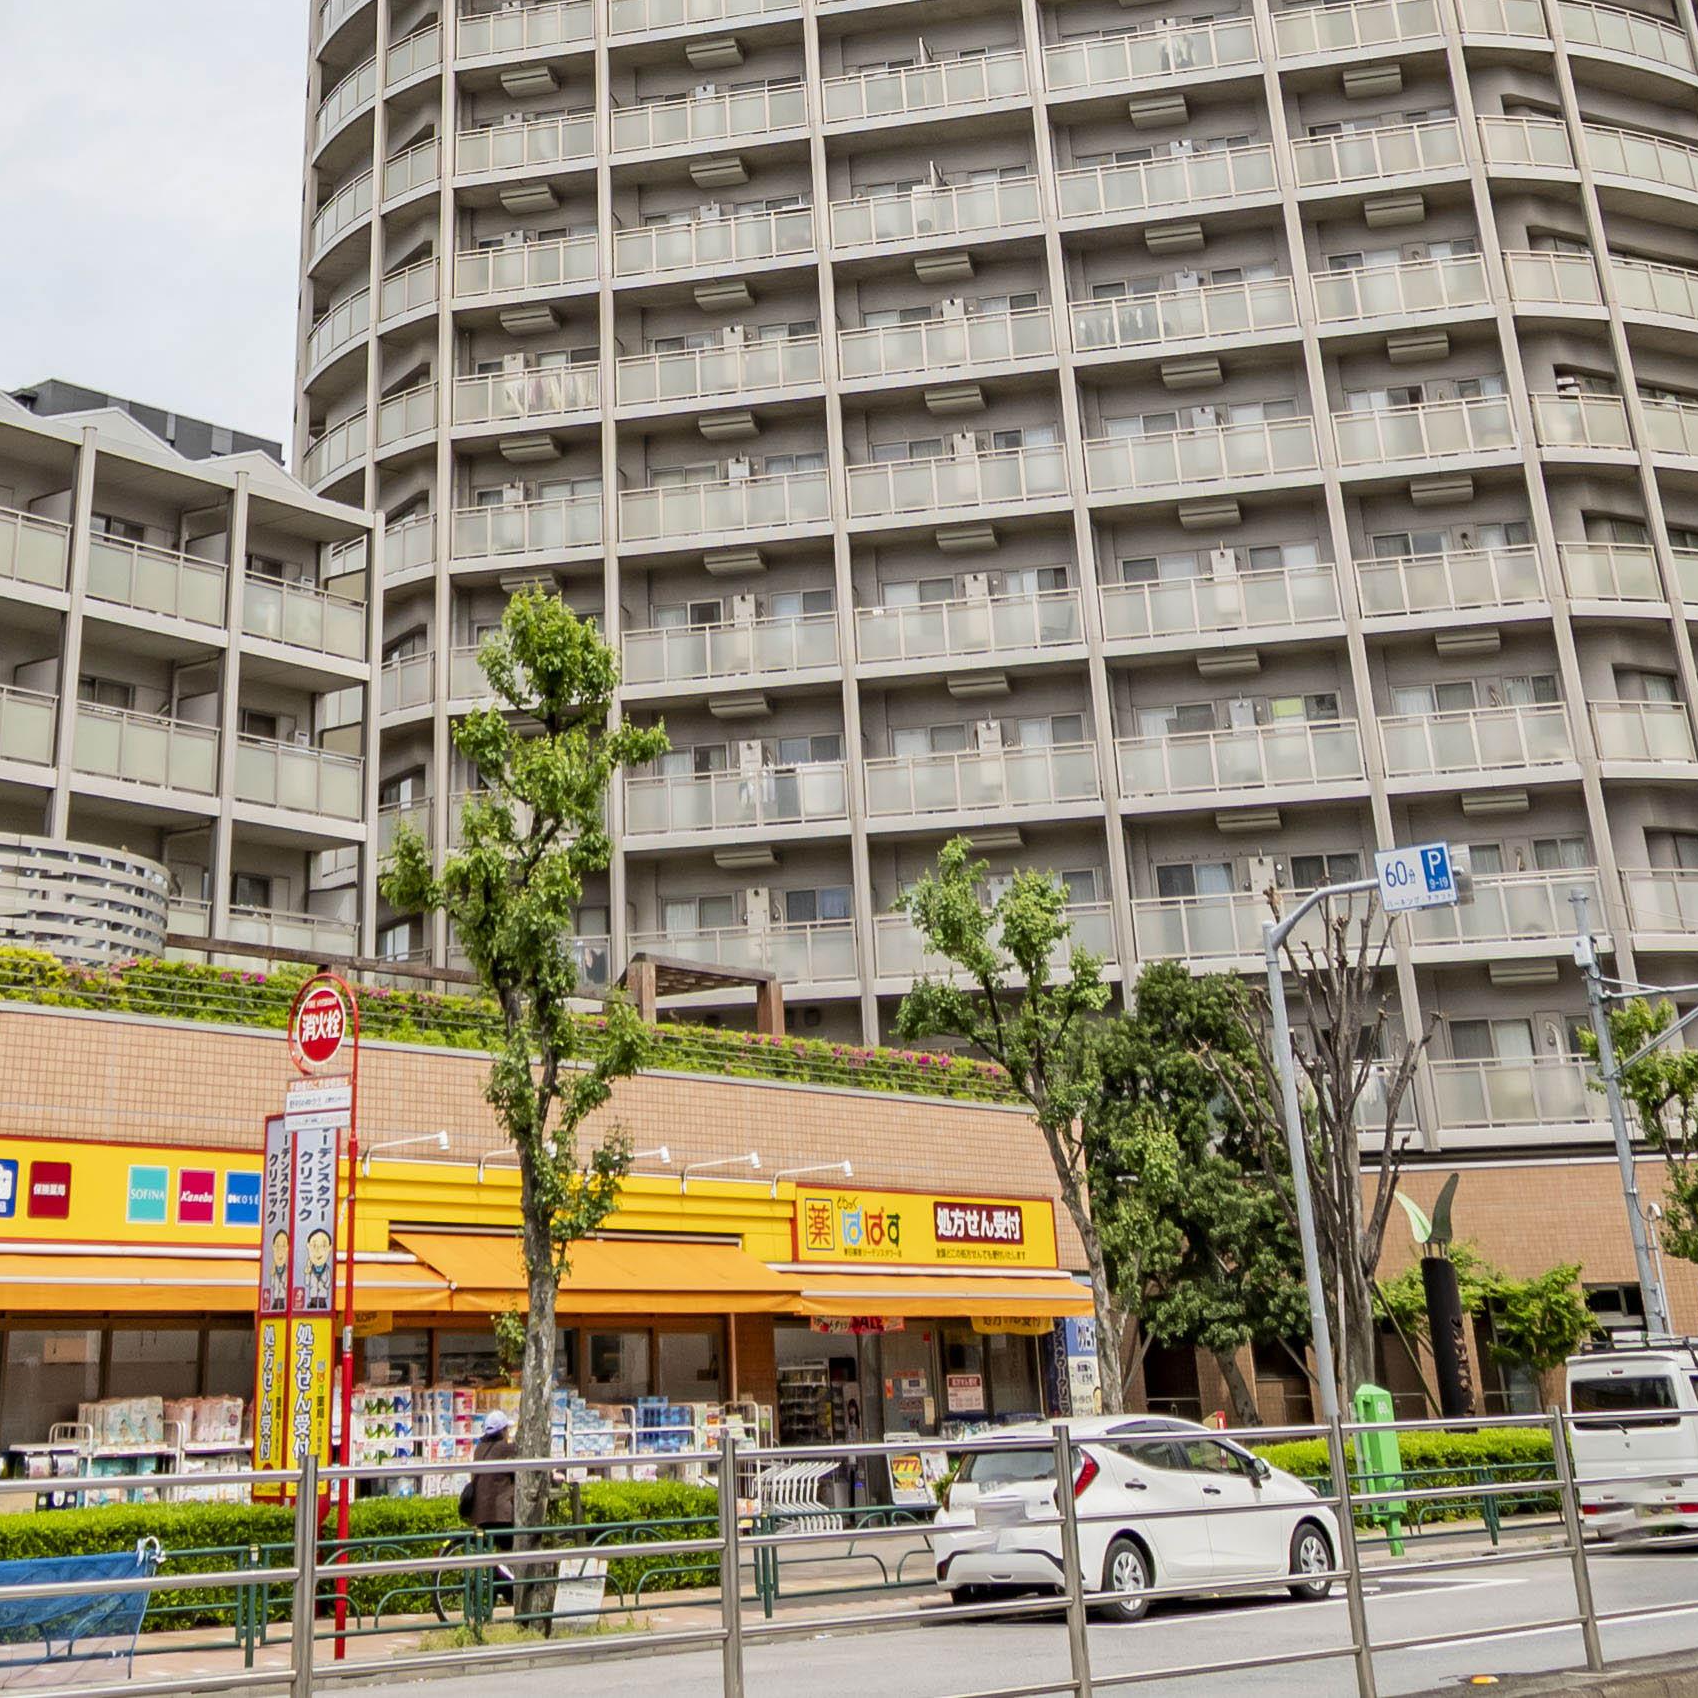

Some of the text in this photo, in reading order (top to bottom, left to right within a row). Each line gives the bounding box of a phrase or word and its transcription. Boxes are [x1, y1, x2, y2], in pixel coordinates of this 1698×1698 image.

[1427, 851, 1442, 876] P
[302, 1009, 342, 1044] 消火栓
[130, 1188, 166, 1201] SOFINA
[180, 1190, 214, 1203] Kanebo
[267, 1153, 279, 1224] クリニック
[298, 1150, 314, 1222] クリニック
[316, 1128, 333, 1222] ーデンスタワー
[807, 1203, 831, 1246] 薬
[936, 1207, 1021, 1240] 処方せん受付
[260, 1324, 275, 1460] 処方せん受付
[293, 1323, 314, 1460] 処方せん受付
